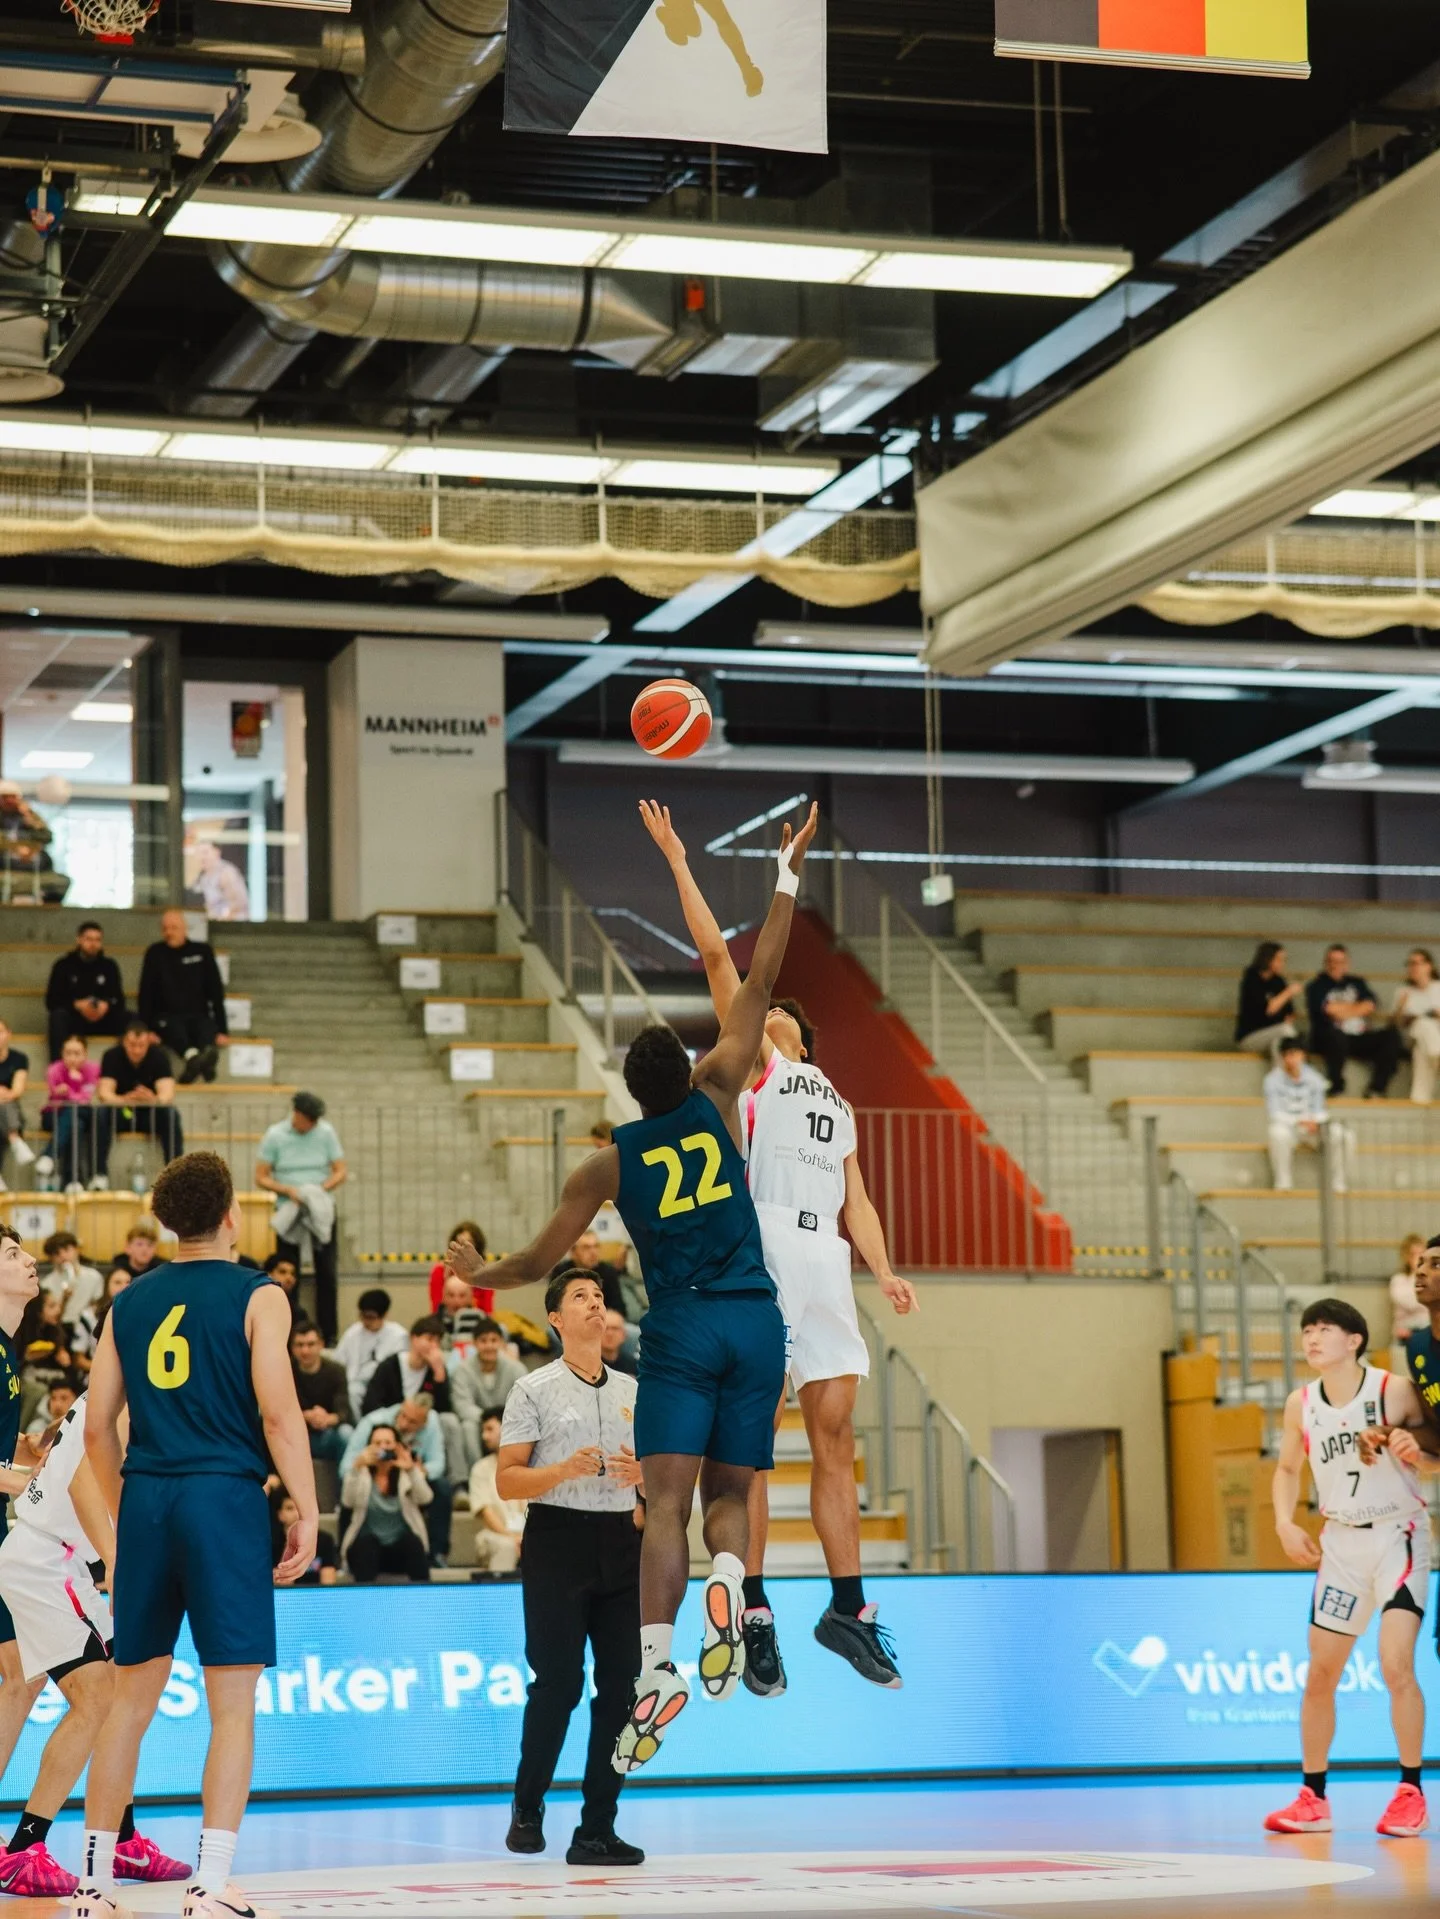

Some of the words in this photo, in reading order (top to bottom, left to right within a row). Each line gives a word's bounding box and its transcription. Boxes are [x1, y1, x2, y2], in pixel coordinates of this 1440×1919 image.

[365, 715, 488, 736] MANNHEIM
[805, 1111, 834, 1143] 10
[641, 1132, 733, 1219] 22
[797, 1147, 837, 1175] SoftBa
[147, 1304, 190, 1390] 6
[1347, 1471, 1361, 1498] 7
